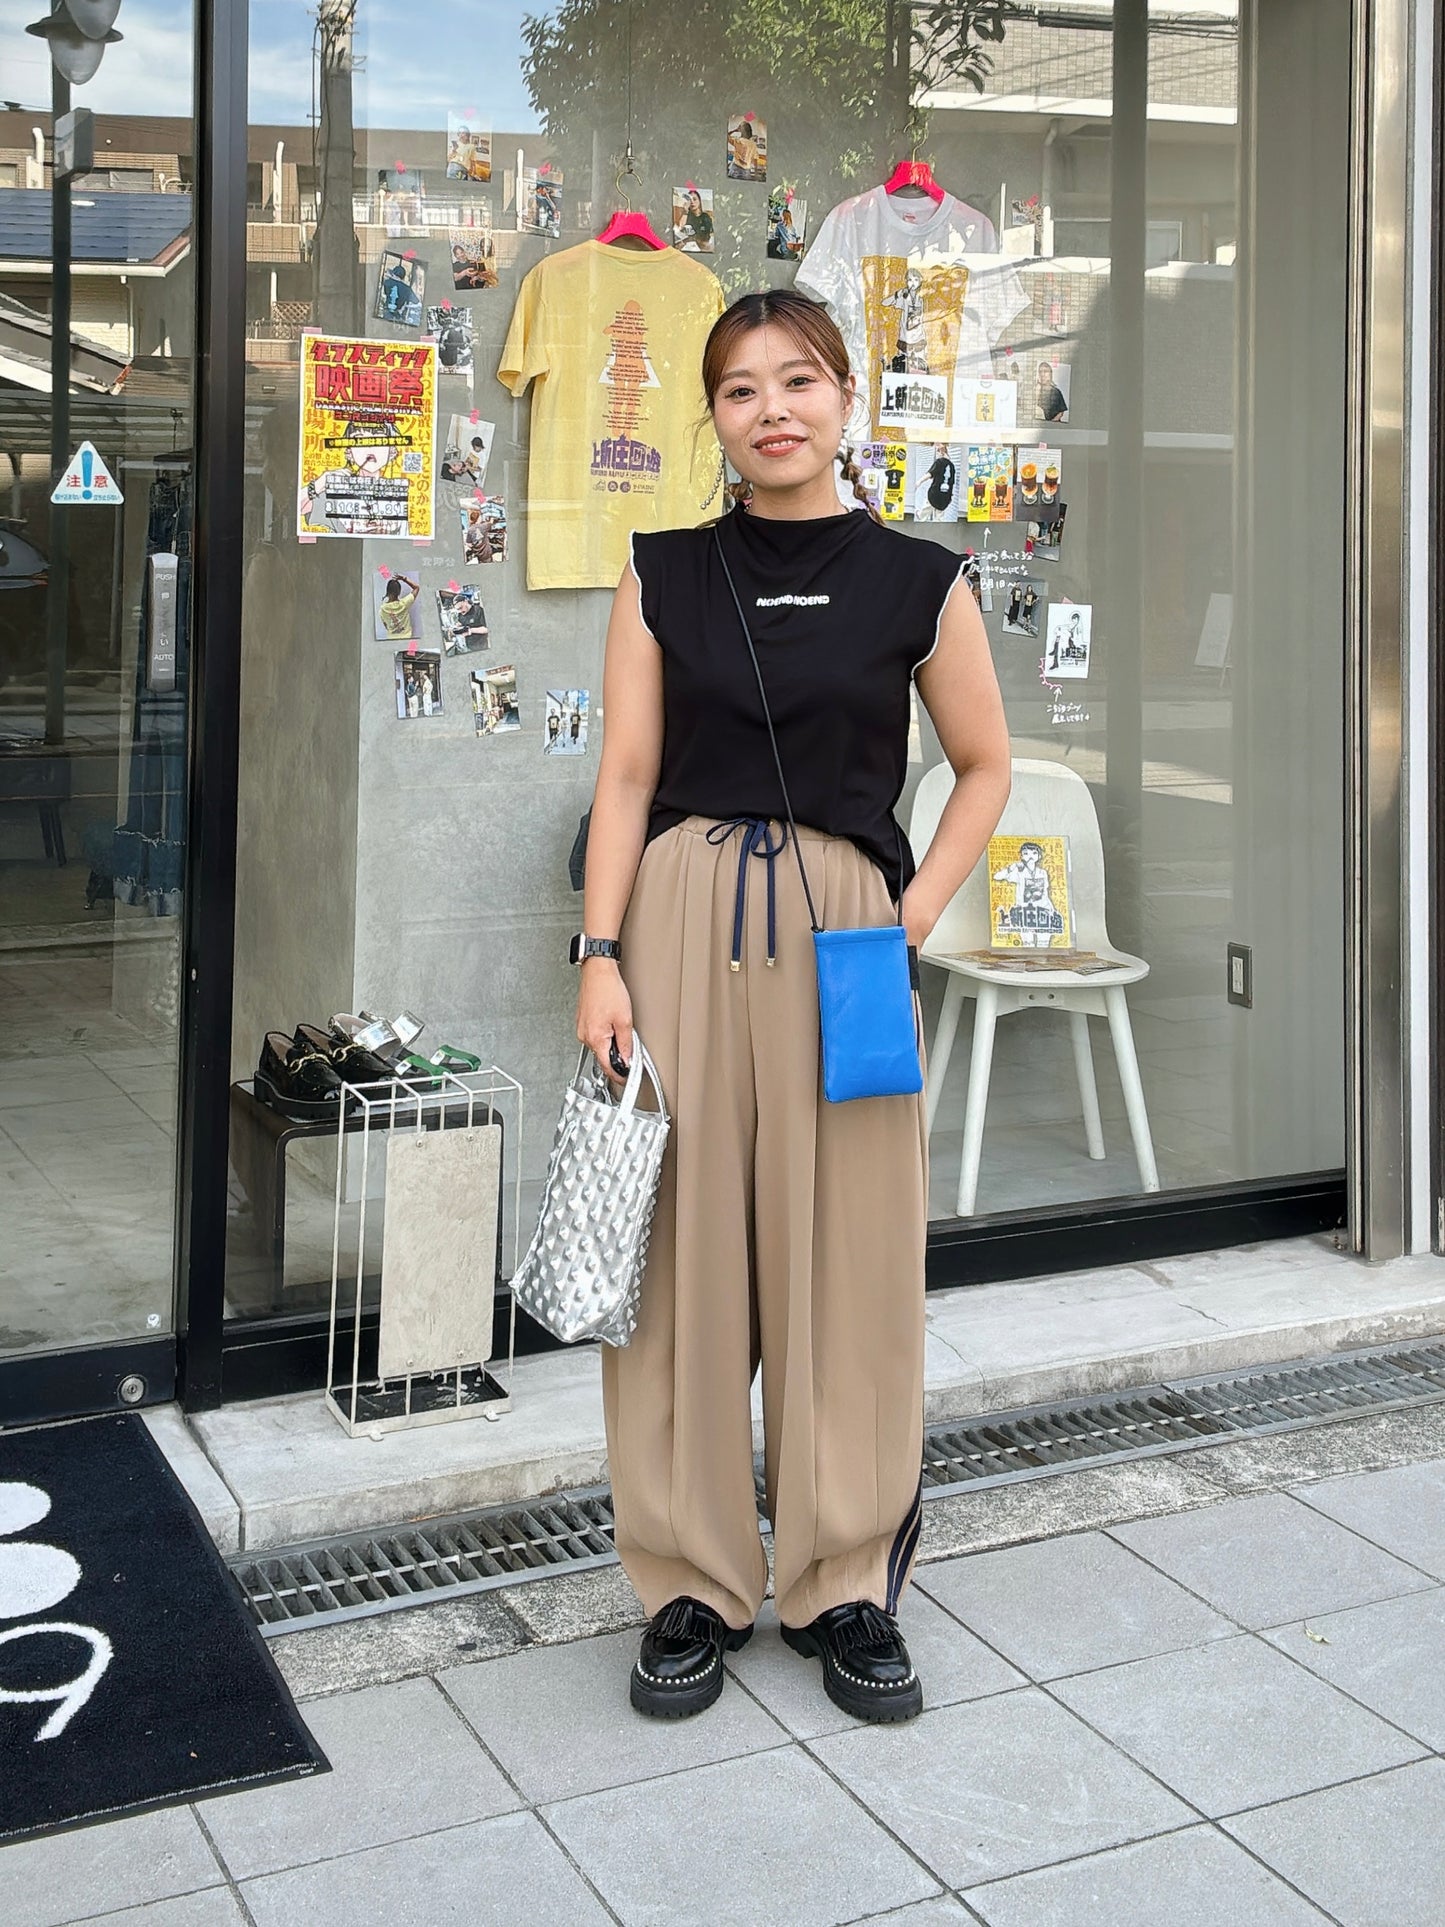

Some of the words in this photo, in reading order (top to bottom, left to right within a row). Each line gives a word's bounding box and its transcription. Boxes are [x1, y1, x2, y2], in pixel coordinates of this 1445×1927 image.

[314, 363, 424, 405] 映画祭
[155, 573, 177, 581] PUSH
[153, 653, 175, 661] AUTO
